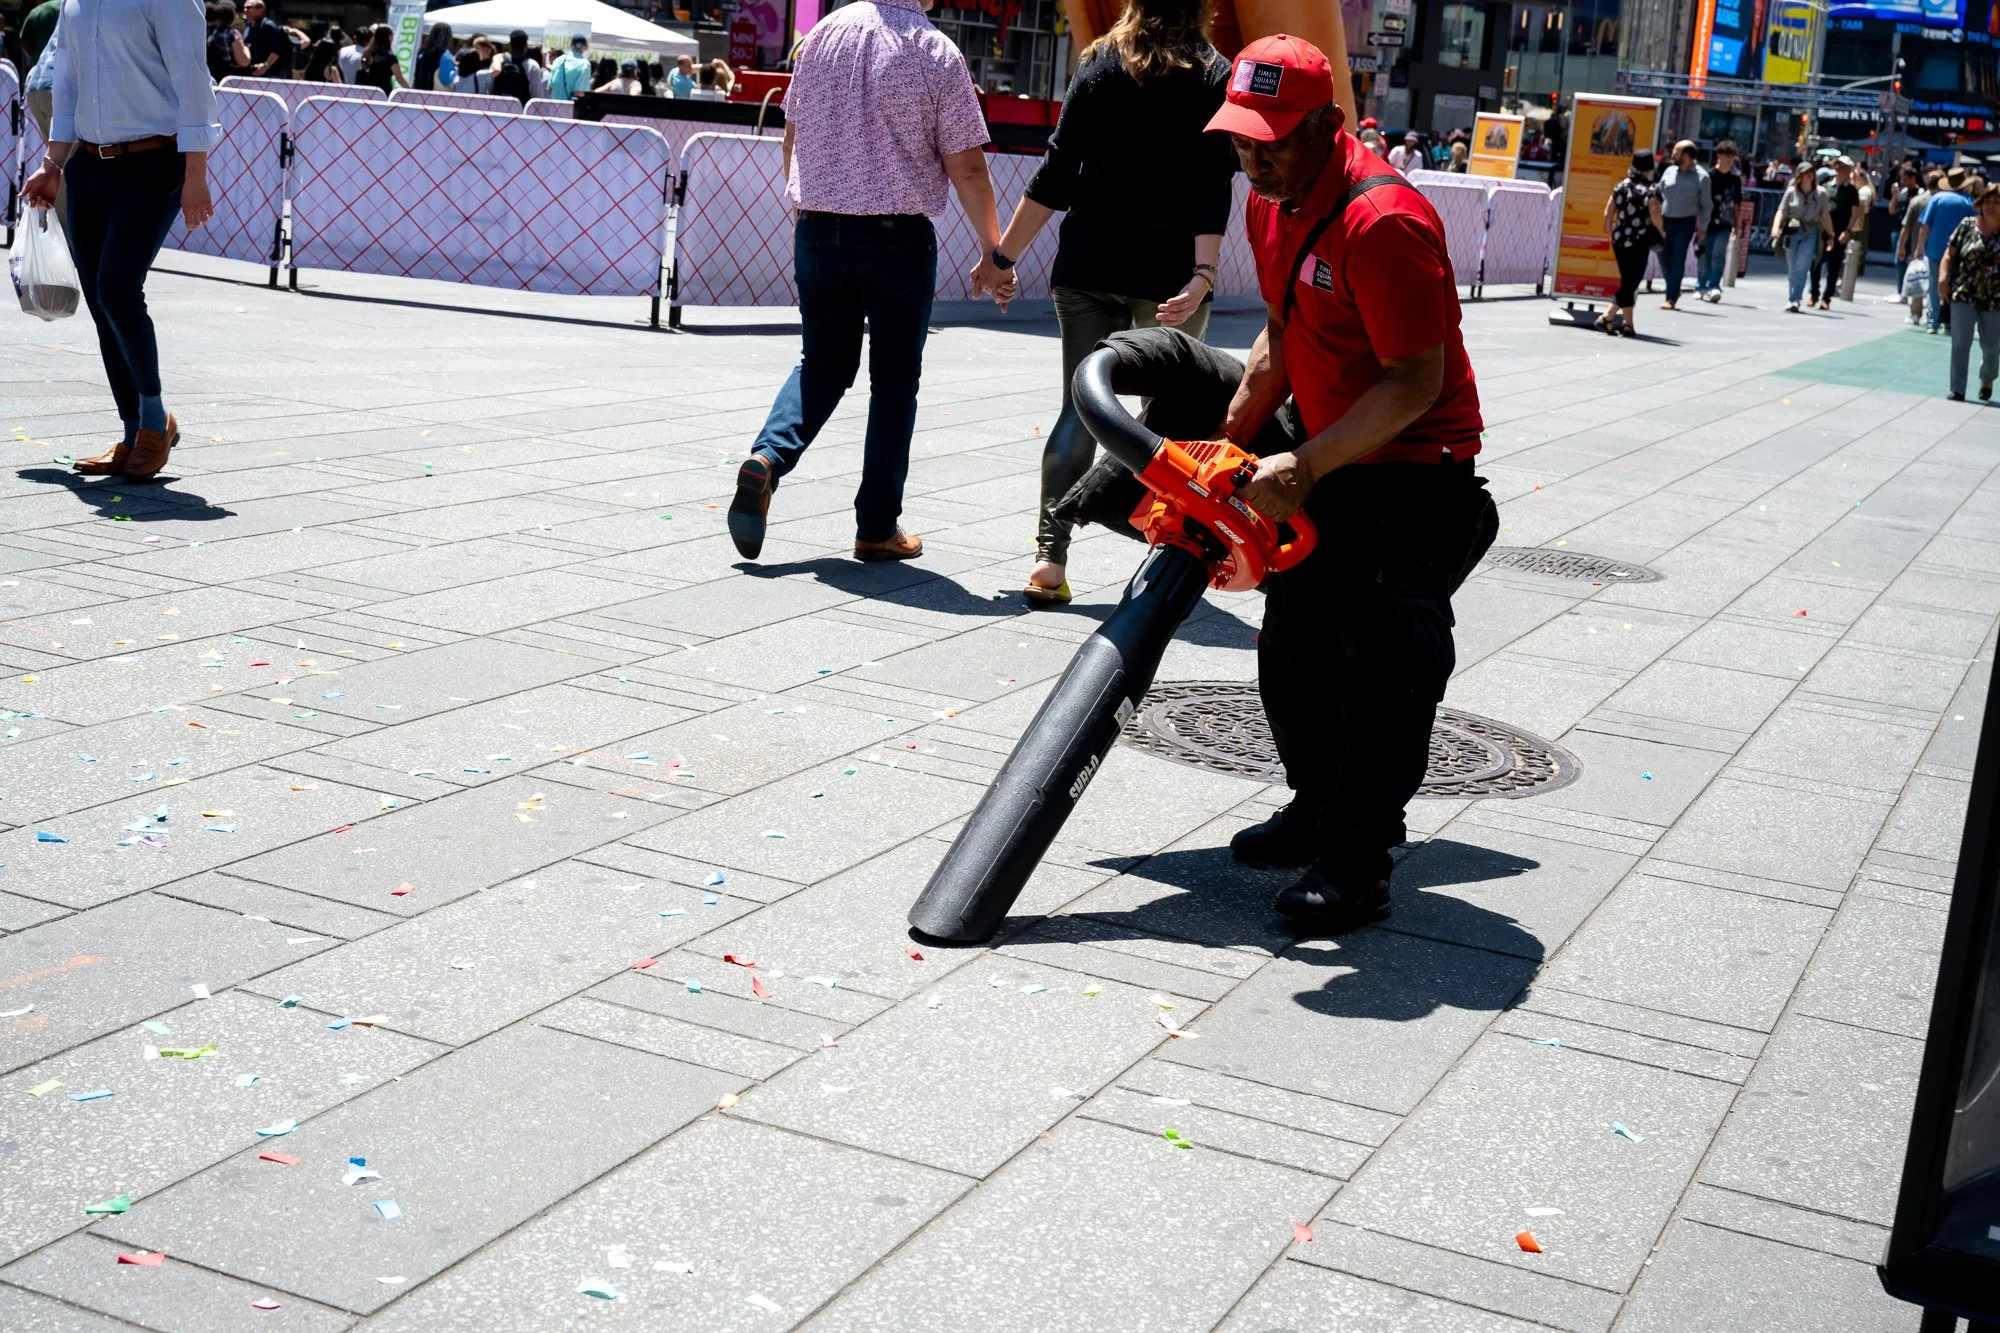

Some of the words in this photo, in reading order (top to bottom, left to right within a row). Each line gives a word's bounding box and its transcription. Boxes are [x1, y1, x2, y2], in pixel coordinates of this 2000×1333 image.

[393, 17, 418, 88] BROA
[1257, 69, 1277, 78] TIMES
[1254, 76, 1277, 86] SQUARE
